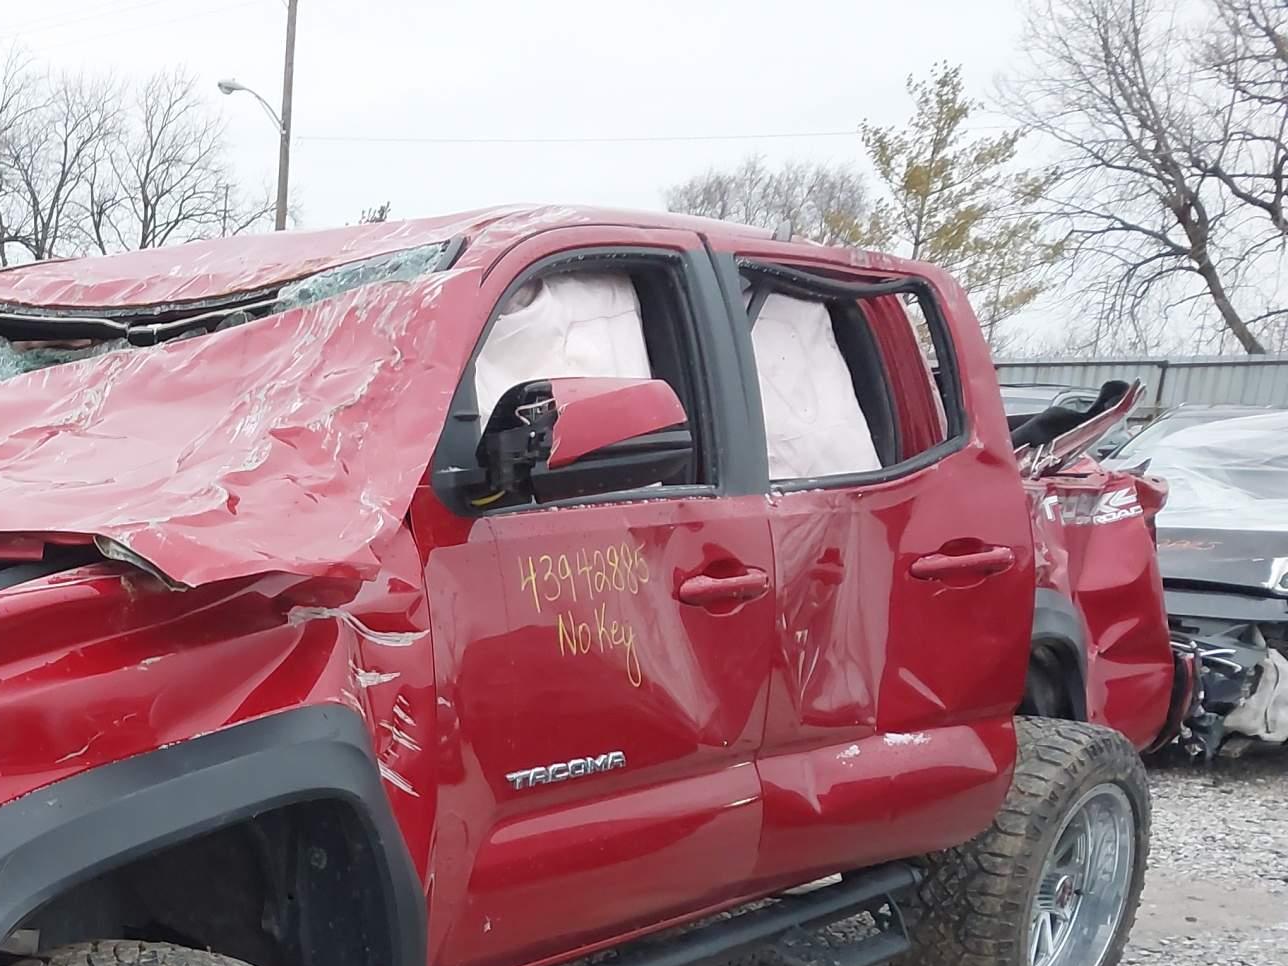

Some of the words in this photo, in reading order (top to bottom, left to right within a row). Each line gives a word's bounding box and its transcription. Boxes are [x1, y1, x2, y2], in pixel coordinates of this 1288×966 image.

[517, 541, 650, 614] 43942885
[557, 610, 592, 657] No
[594, 602, 642, 688] Key
[505, 751, 626, 790] TACOMA
